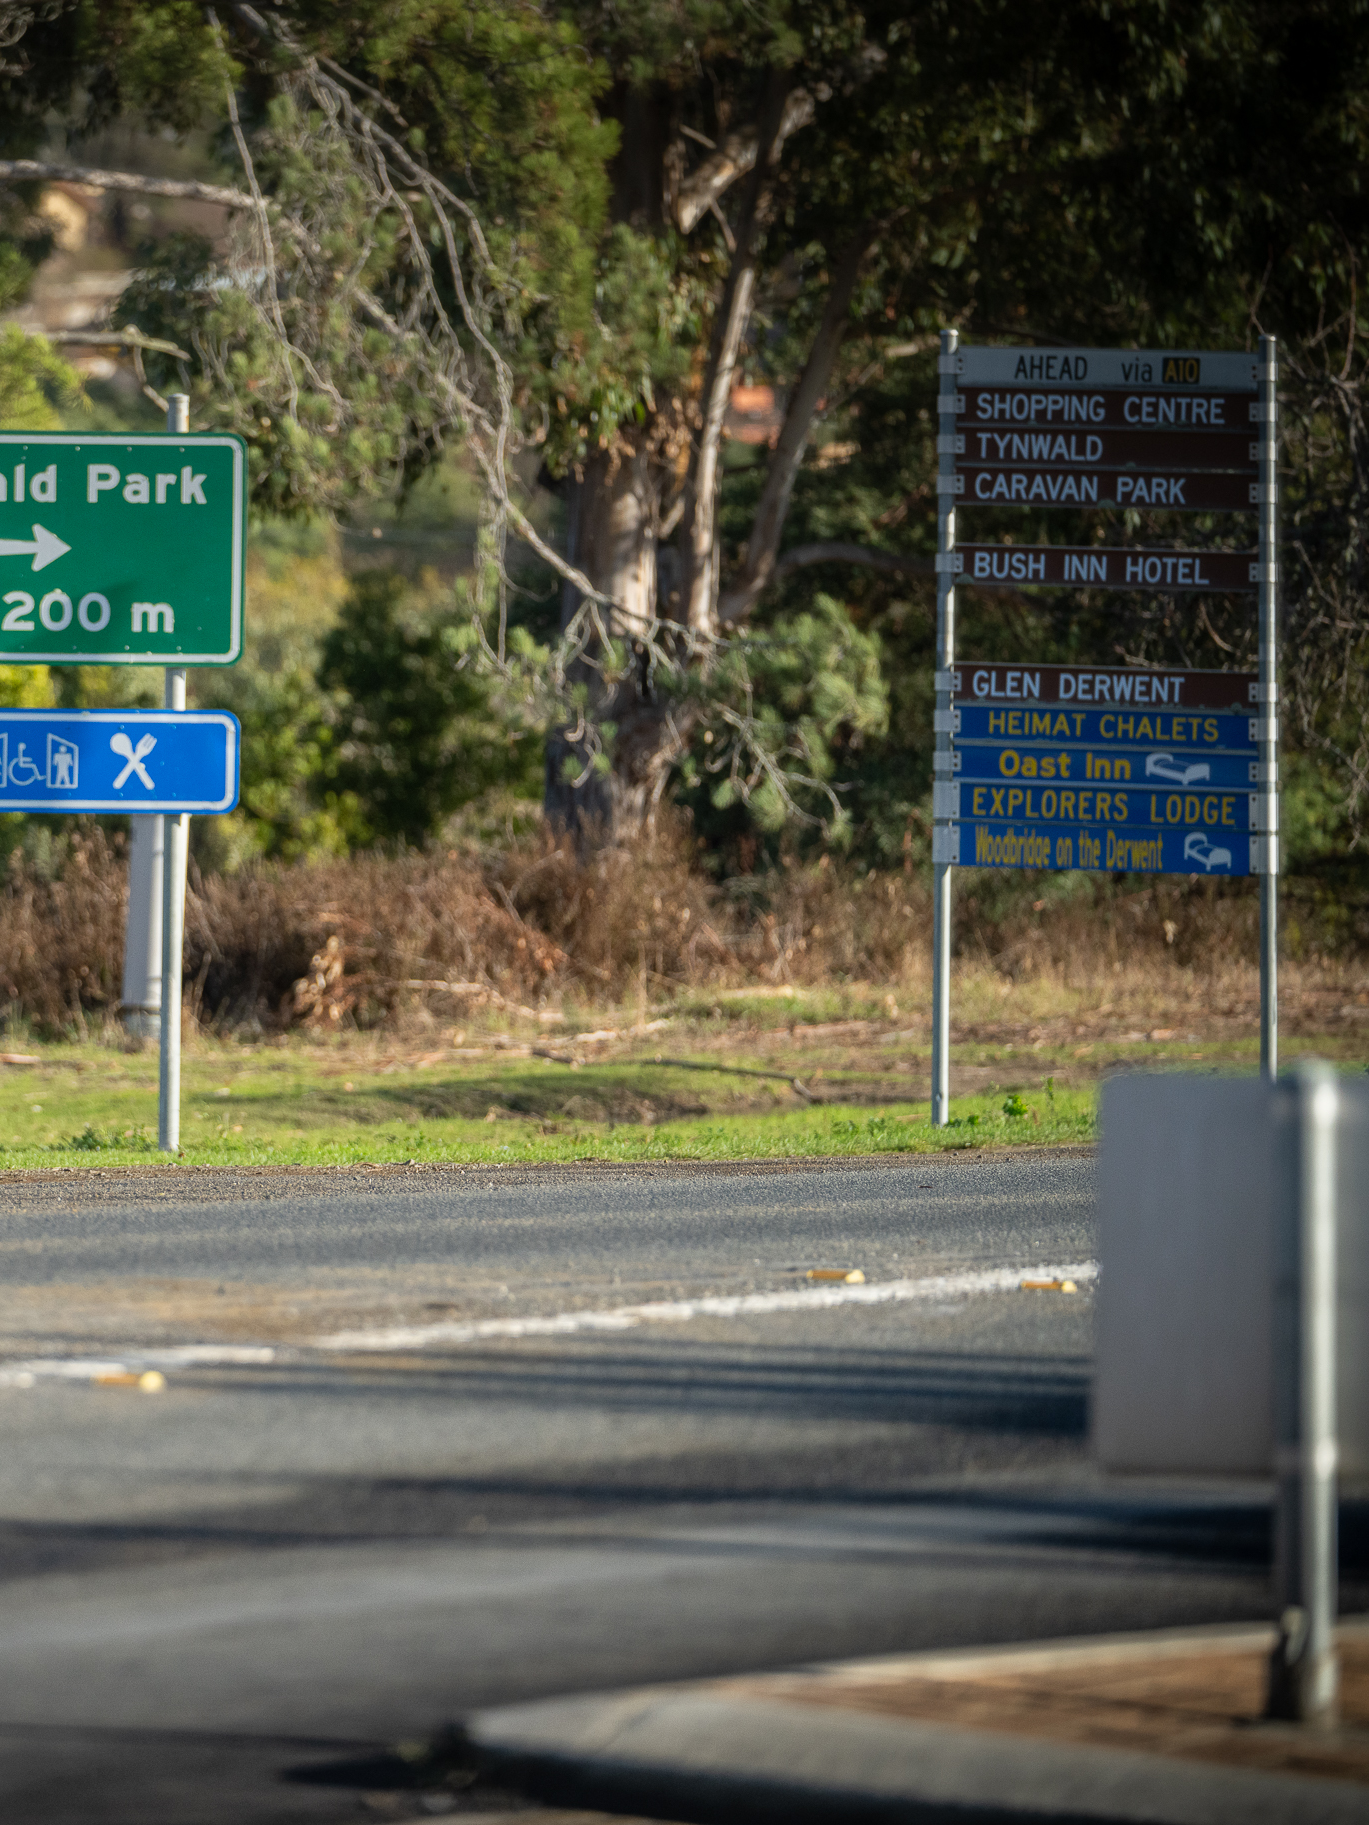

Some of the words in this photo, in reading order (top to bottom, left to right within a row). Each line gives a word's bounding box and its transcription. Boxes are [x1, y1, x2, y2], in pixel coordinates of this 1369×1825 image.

[1014, 355, 1089, 382] AHEAD
[1121, 357, 1153, 383] via
[1163, 358, 1200, 384] A10
[976, 392, 1107, 422] SHOPPING
[1123, 396, 1226, 425] CENTRE
[976, 432, 1104, 462] TYNWALD
[87, 463, 208, 505] Park
[974, 472, 1099, 503] CARAVAN
[1116, 476, 1187, 506] PARK
[973, 551, 1046, 581] BUSH
[1063, 553, 1108, 583] INN
[1125, 556, 1210, 586] HOTEL
[1, 589, 112, 633] 200
[131, 601, 176, 634] m
[972, 670, 1041, 699] GLEN
[1058, 673, 1186, 704] DERWENT
[988, 710, 1087, 738] HEIMAT
[1099, 714, 1220, 743] CHALETS
[998, 749, 1071, 779] Oast
[1085, 752, 1132, 781] Inn
[972, 786, 1129, 822] EXPLORERS
[1150, 794, 1237, 826] LODGE
[974, 825, 1051, 867] Woodbridge
[1055, 837, 1073, 867] on
[1078, 830, 1102, 869] the
[1105, 829, 1164, 871] Derwent
